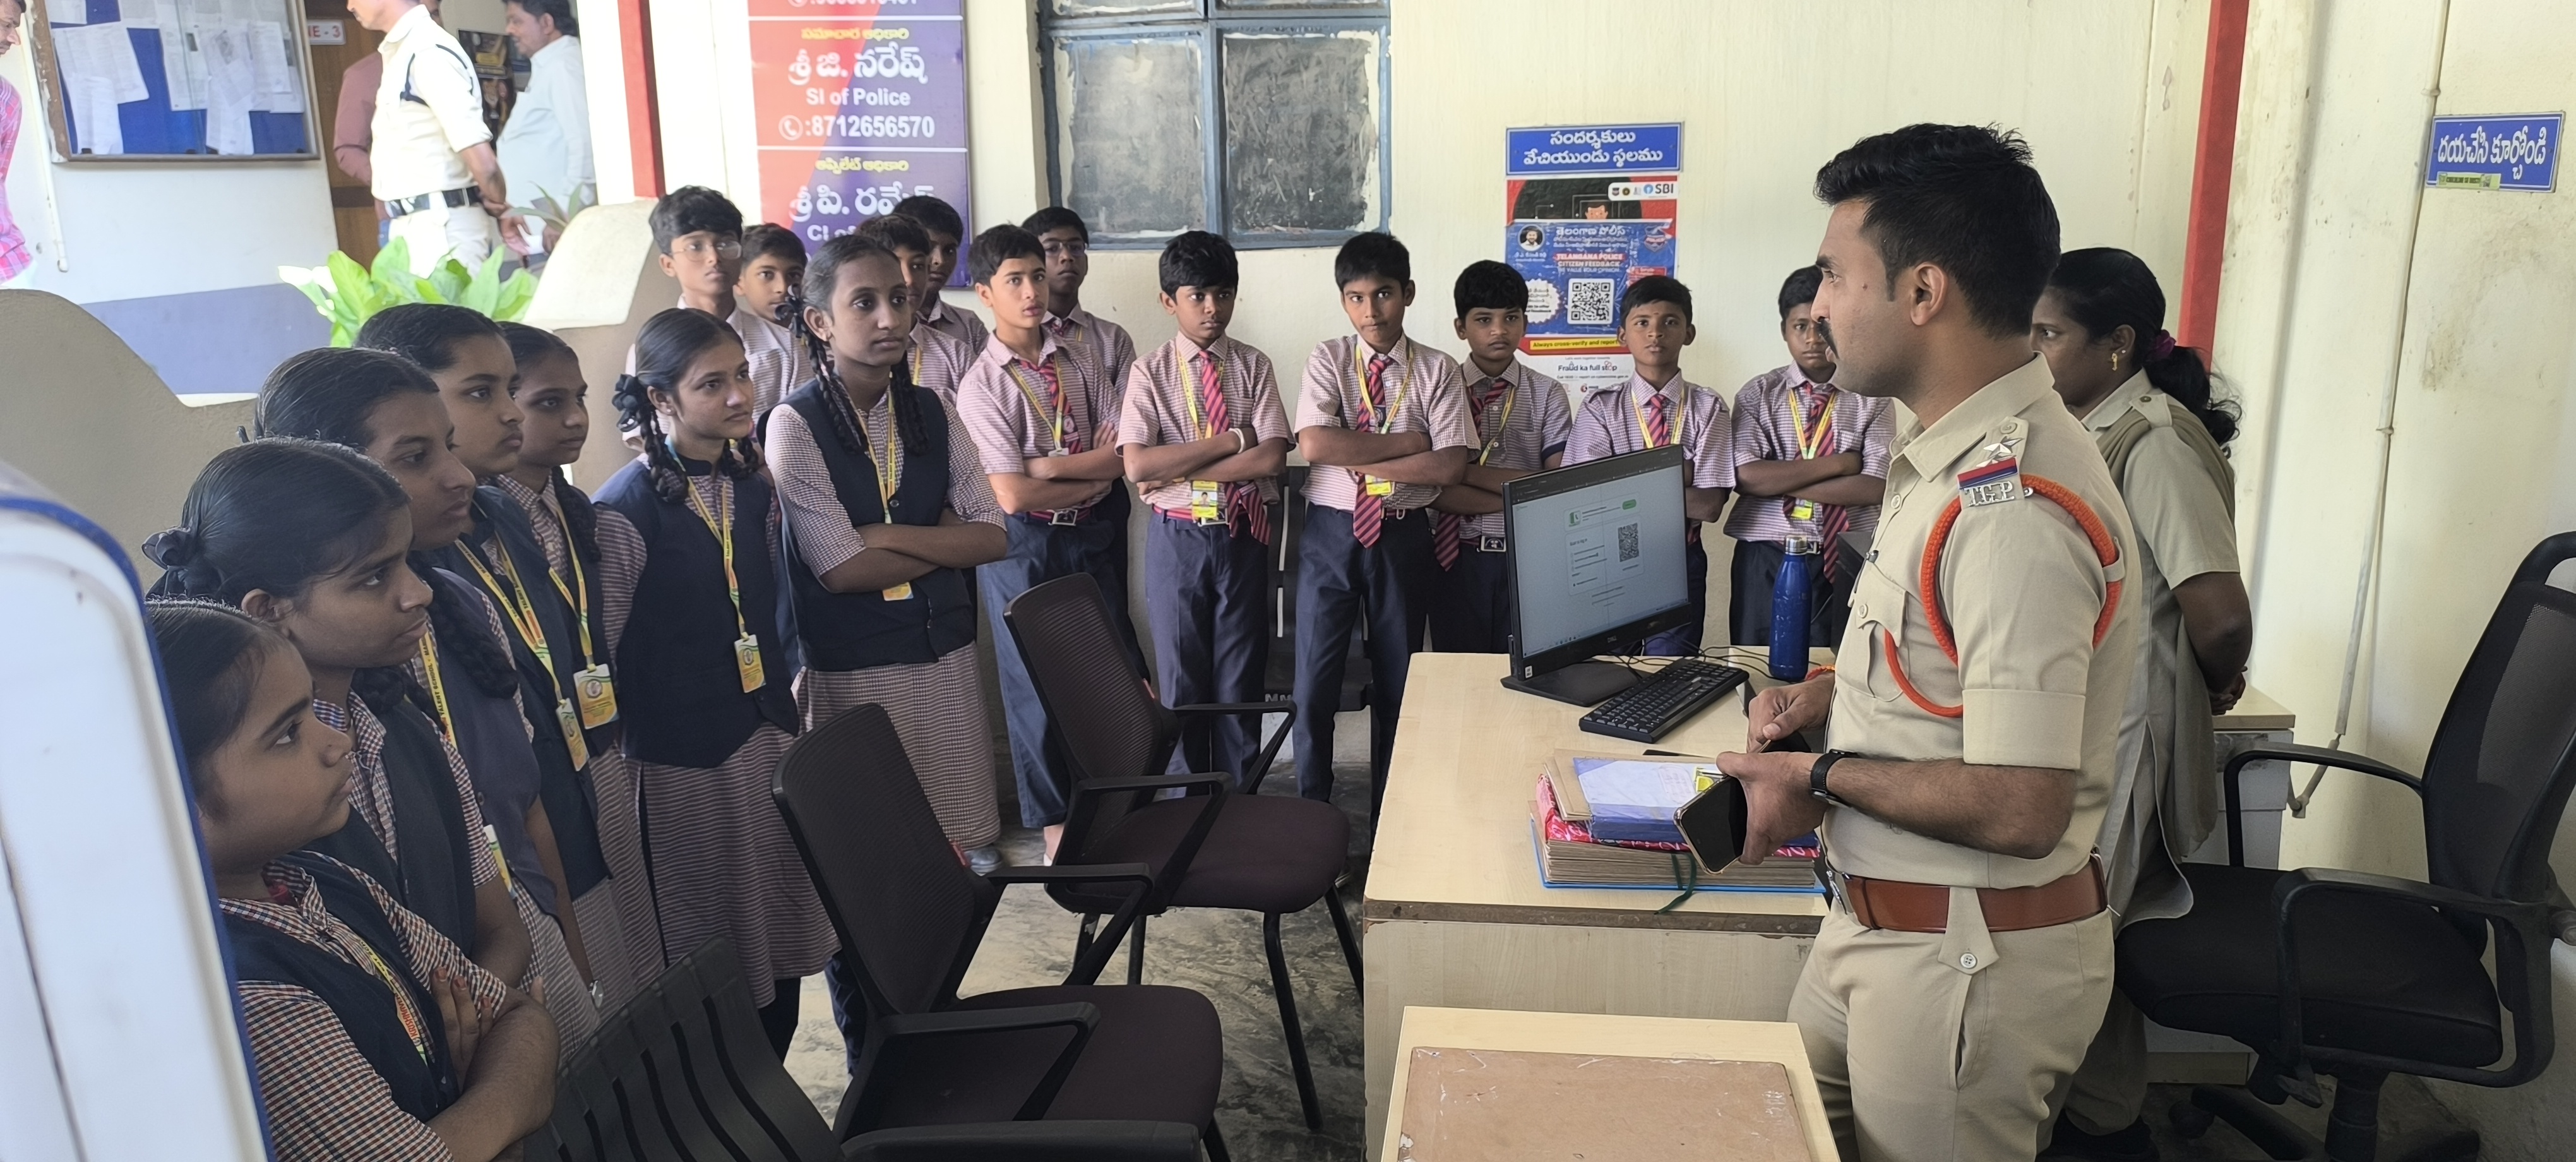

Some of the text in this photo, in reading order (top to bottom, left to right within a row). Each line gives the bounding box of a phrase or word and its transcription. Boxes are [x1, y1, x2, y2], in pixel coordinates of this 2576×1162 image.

[332, 25, 341, 38] 3
[788, 49, 812, 85] శ్రీ
[806, 87, 911, 106] SI of Police
[1550, 130, 1637, 150] సందర్శకులు
[1655, 183, 1674, 194] SBI
[789, 185, 813, 222] శ్రీ
[1964, 481, 2015, 506] TGP
[427, 663, 439, 689] SCHOOL
[434, 692, 445, 715] TALENT
